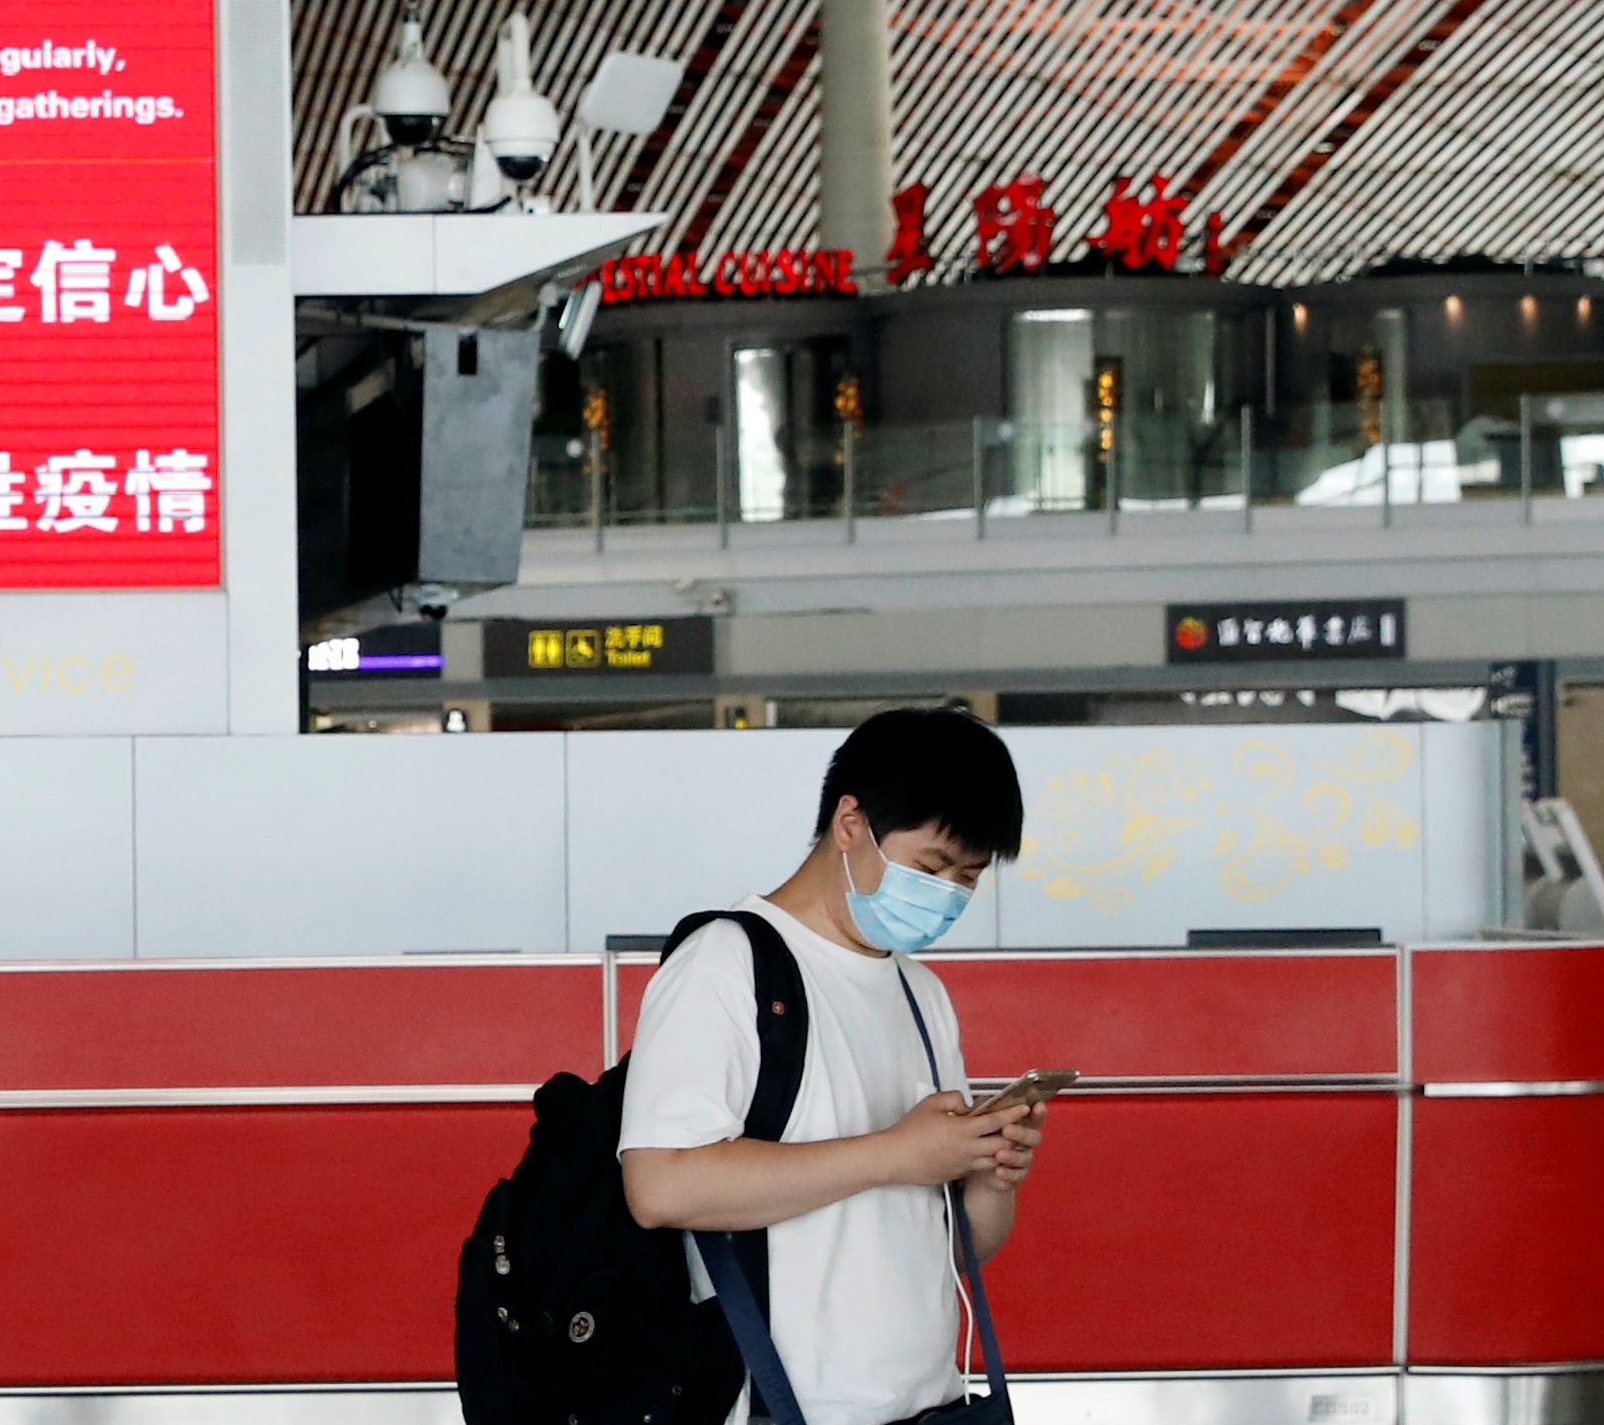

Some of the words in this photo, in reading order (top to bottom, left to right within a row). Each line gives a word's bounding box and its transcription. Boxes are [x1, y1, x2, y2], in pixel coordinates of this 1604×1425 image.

[578, 250, 707, 303] ESTIAL
[715, 247, 859, 299] CUISINE
[605, 625, 663, 648] 洗手间
